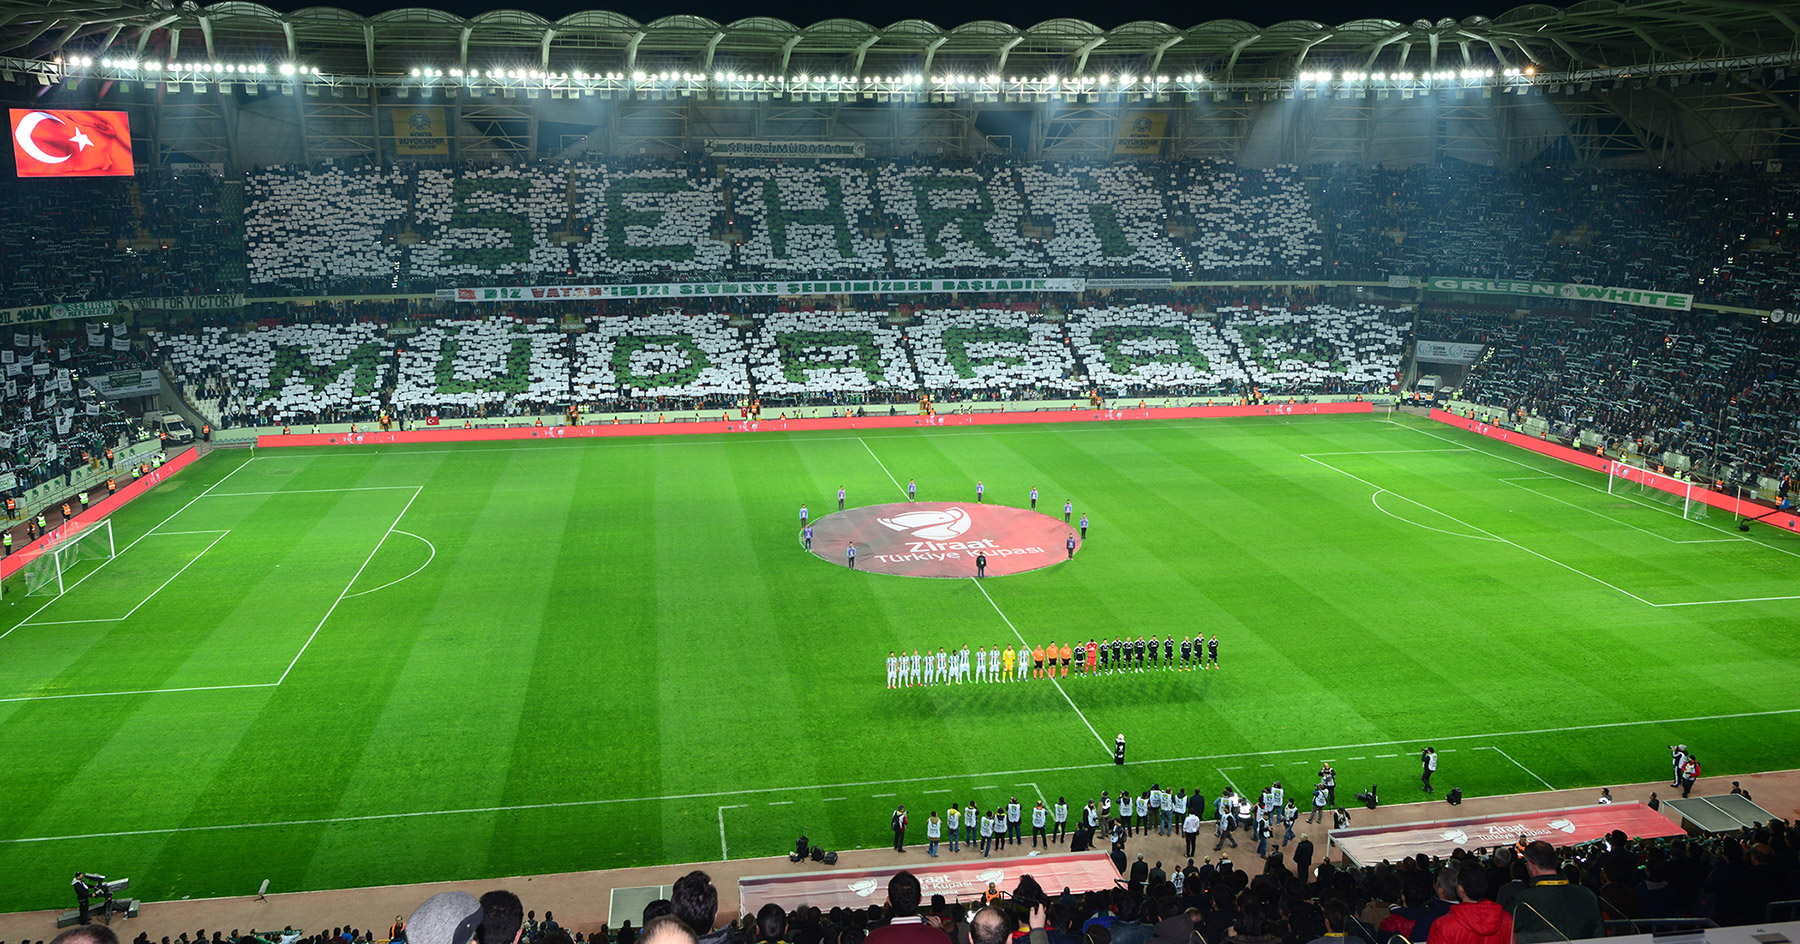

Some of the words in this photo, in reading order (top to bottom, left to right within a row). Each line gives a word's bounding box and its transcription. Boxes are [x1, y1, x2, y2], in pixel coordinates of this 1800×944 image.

[484, 287, 522, 300] BİZ
[679, 283, 779, 296] SEVMEYE
[1434, 279, 1555, 295] GREEN
[1569, 285, 1690, 308] WHITE
[163, 297, 184, 308] FOR
[905, 538, 1000, 552] Ziraat
[874, 551, 961, 563] Türkiye
[1484, 823, 1529, 834] Ziraat
[919, 874, 951, 884] raat
[932, 881, 973, 889] Kupası
